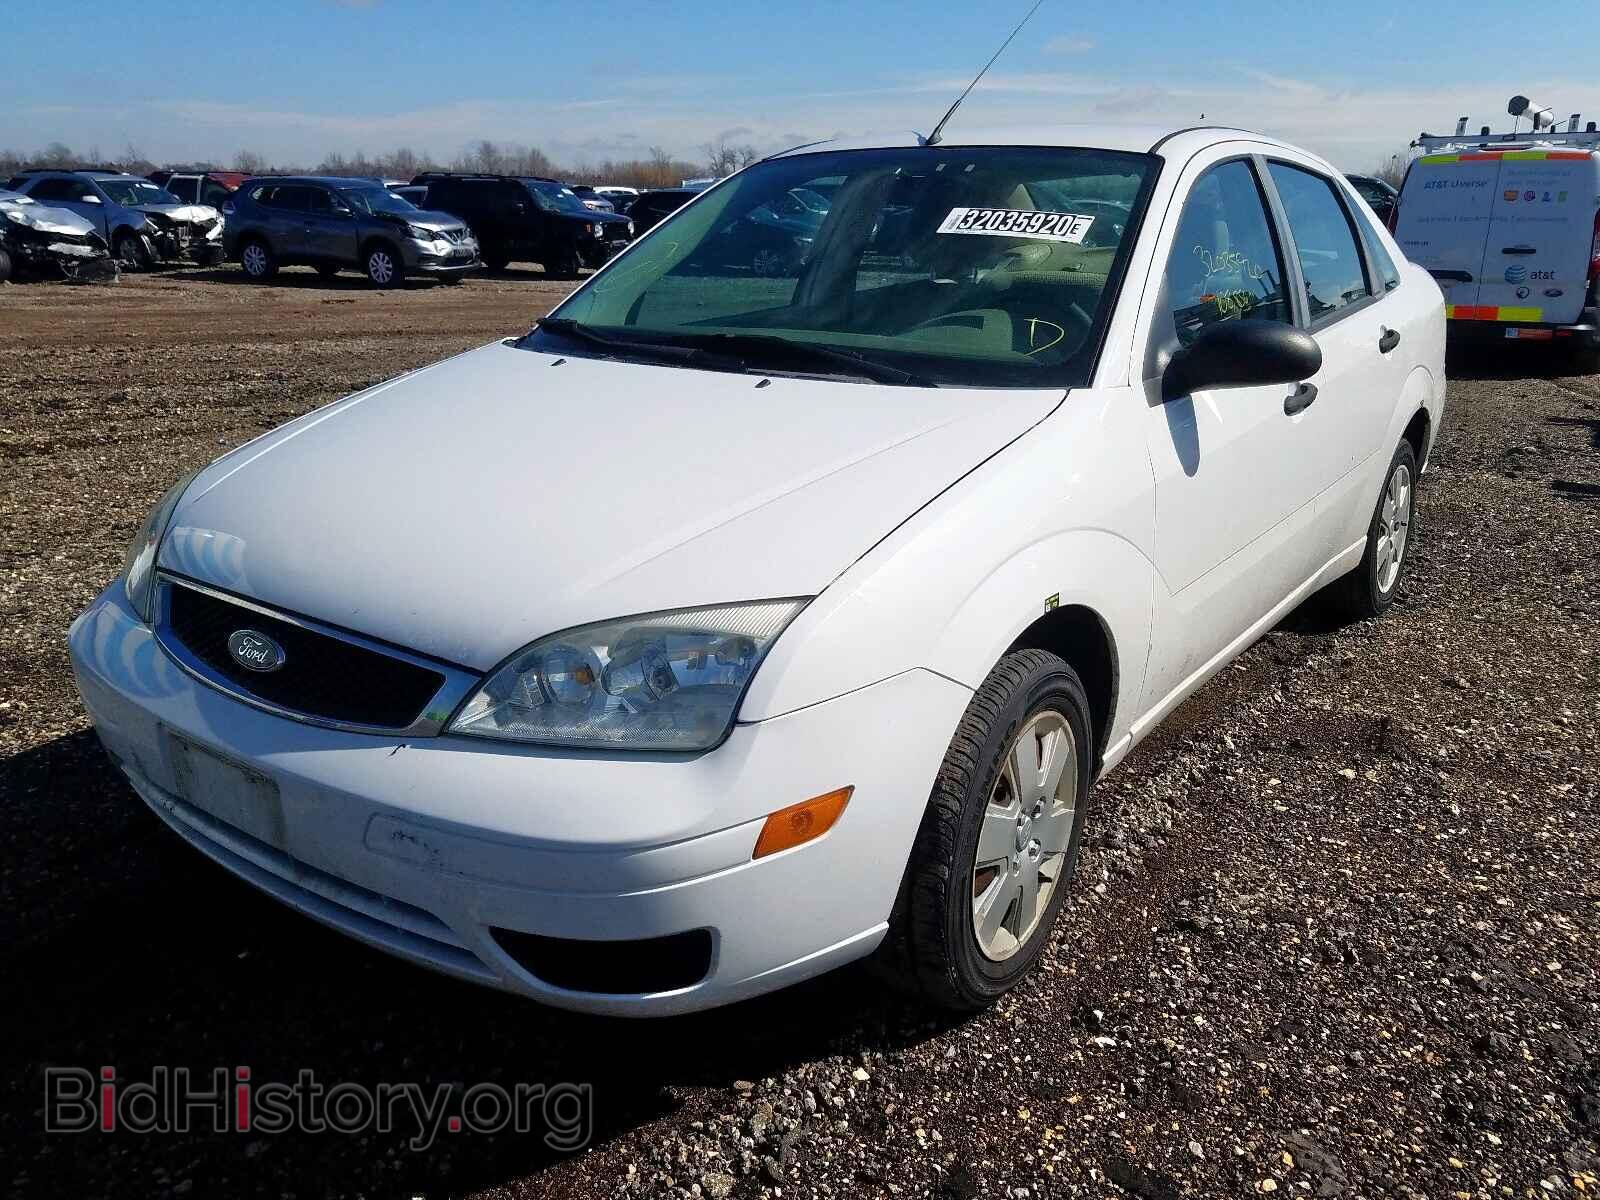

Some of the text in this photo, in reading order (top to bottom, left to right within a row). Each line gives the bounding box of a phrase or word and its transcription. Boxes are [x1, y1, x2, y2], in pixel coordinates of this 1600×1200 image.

[1424, 180, 1447, 190] AT&T
[959, 209, 1074, 236] 32035920
[238, 636, 268, 664] Ford
